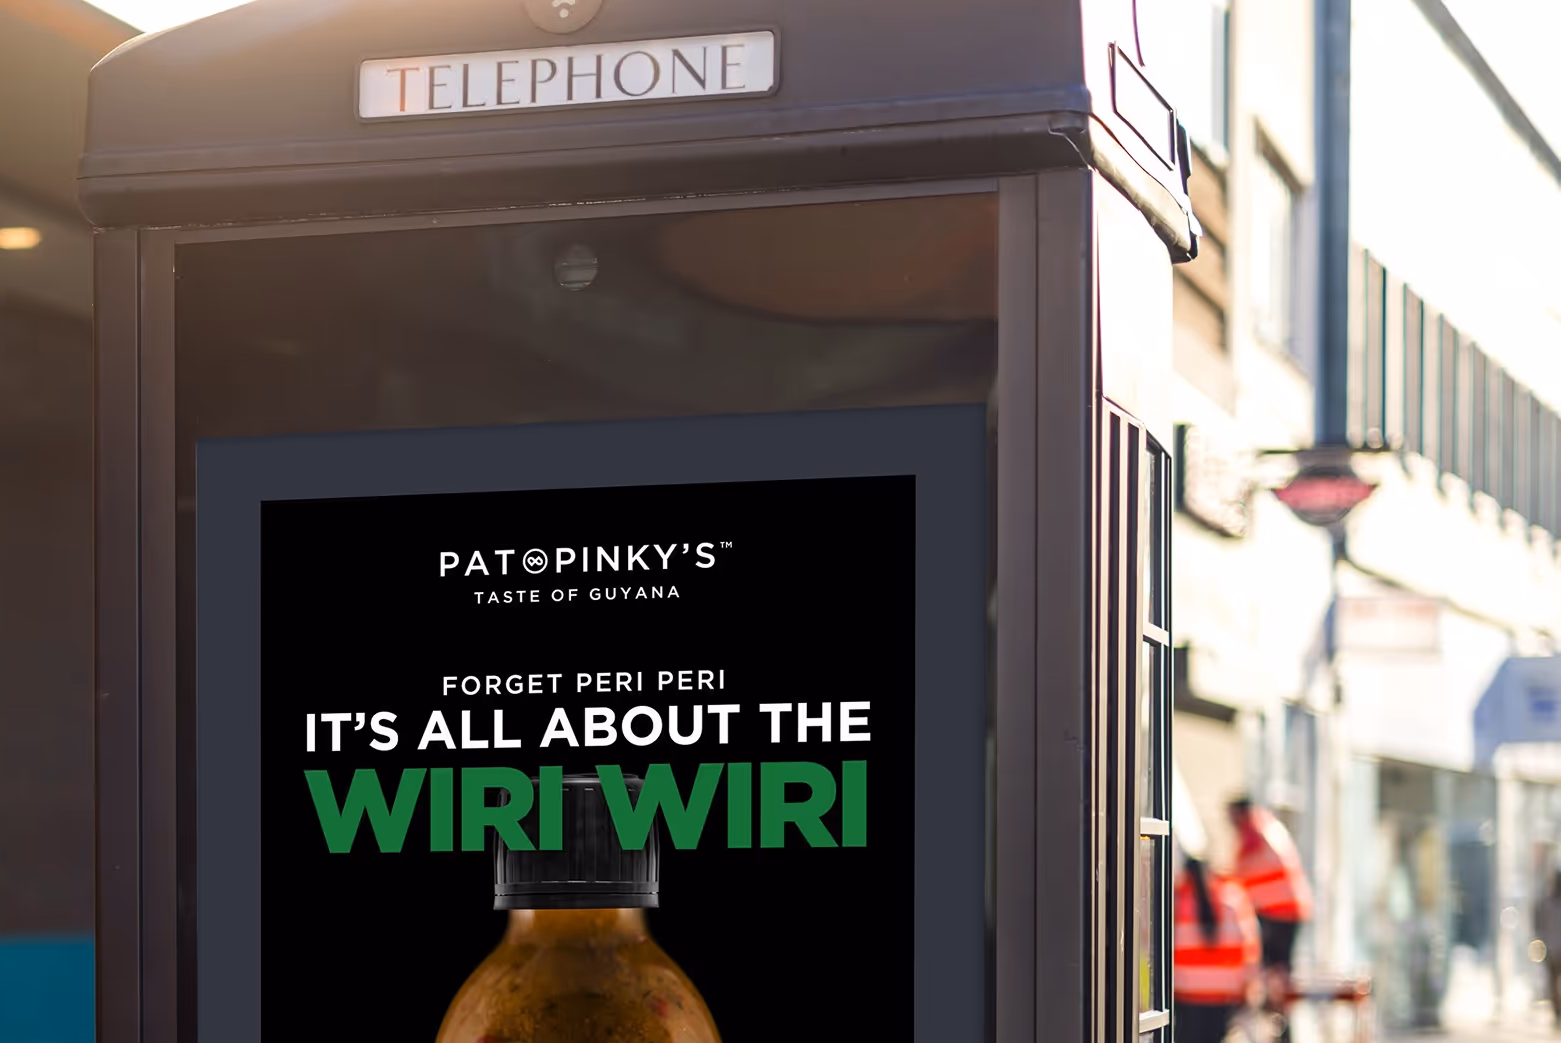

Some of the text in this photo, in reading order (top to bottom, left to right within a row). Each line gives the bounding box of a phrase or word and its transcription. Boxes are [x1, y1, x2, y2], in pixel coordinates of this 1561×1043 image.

[386, 44, 746, 112] TELEPHONE
[439, 549, 515, 577] PAT
[473, 585, 680, 604] TASTE OF GUYANA
[443, 669, 725, 696] FORGET PERI PERI
[306, 701, 872, 752] IT'S ALL ABOUT THE
[303, 760, 867, 854] WIRI WIRI
